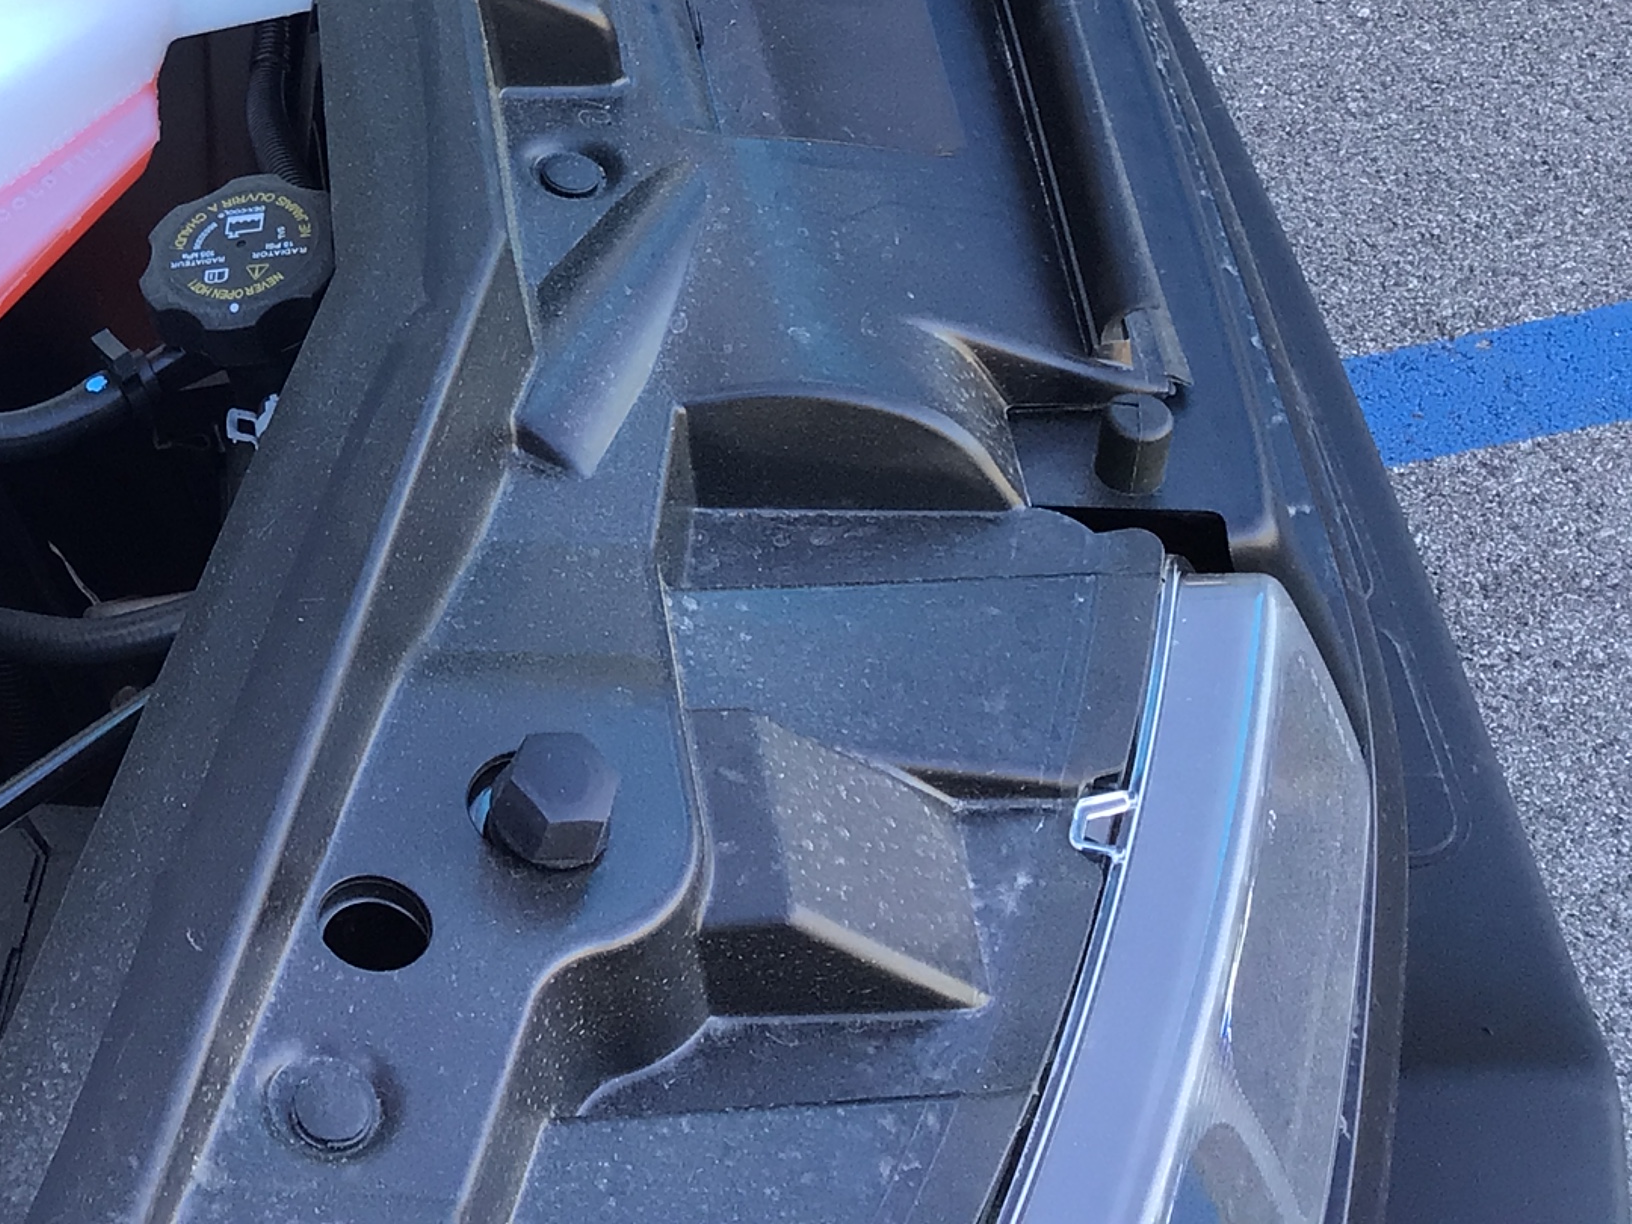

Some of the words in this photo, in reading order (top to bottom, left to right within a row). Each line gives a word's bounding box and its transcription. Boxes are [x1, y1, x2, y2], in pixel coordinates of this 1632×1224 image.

[221, 193, 275, 207] OUVRIR
[276, 195, 308, 221] JAMAIS
[298, 224, 312, 238] NE
[251, 247, 307, 258] RADIATOR
[170, 256, 226, 269] RADIATEUR
[245, 272, 284, 295] NEVER
[213, 288, 243, 299] OPEN
